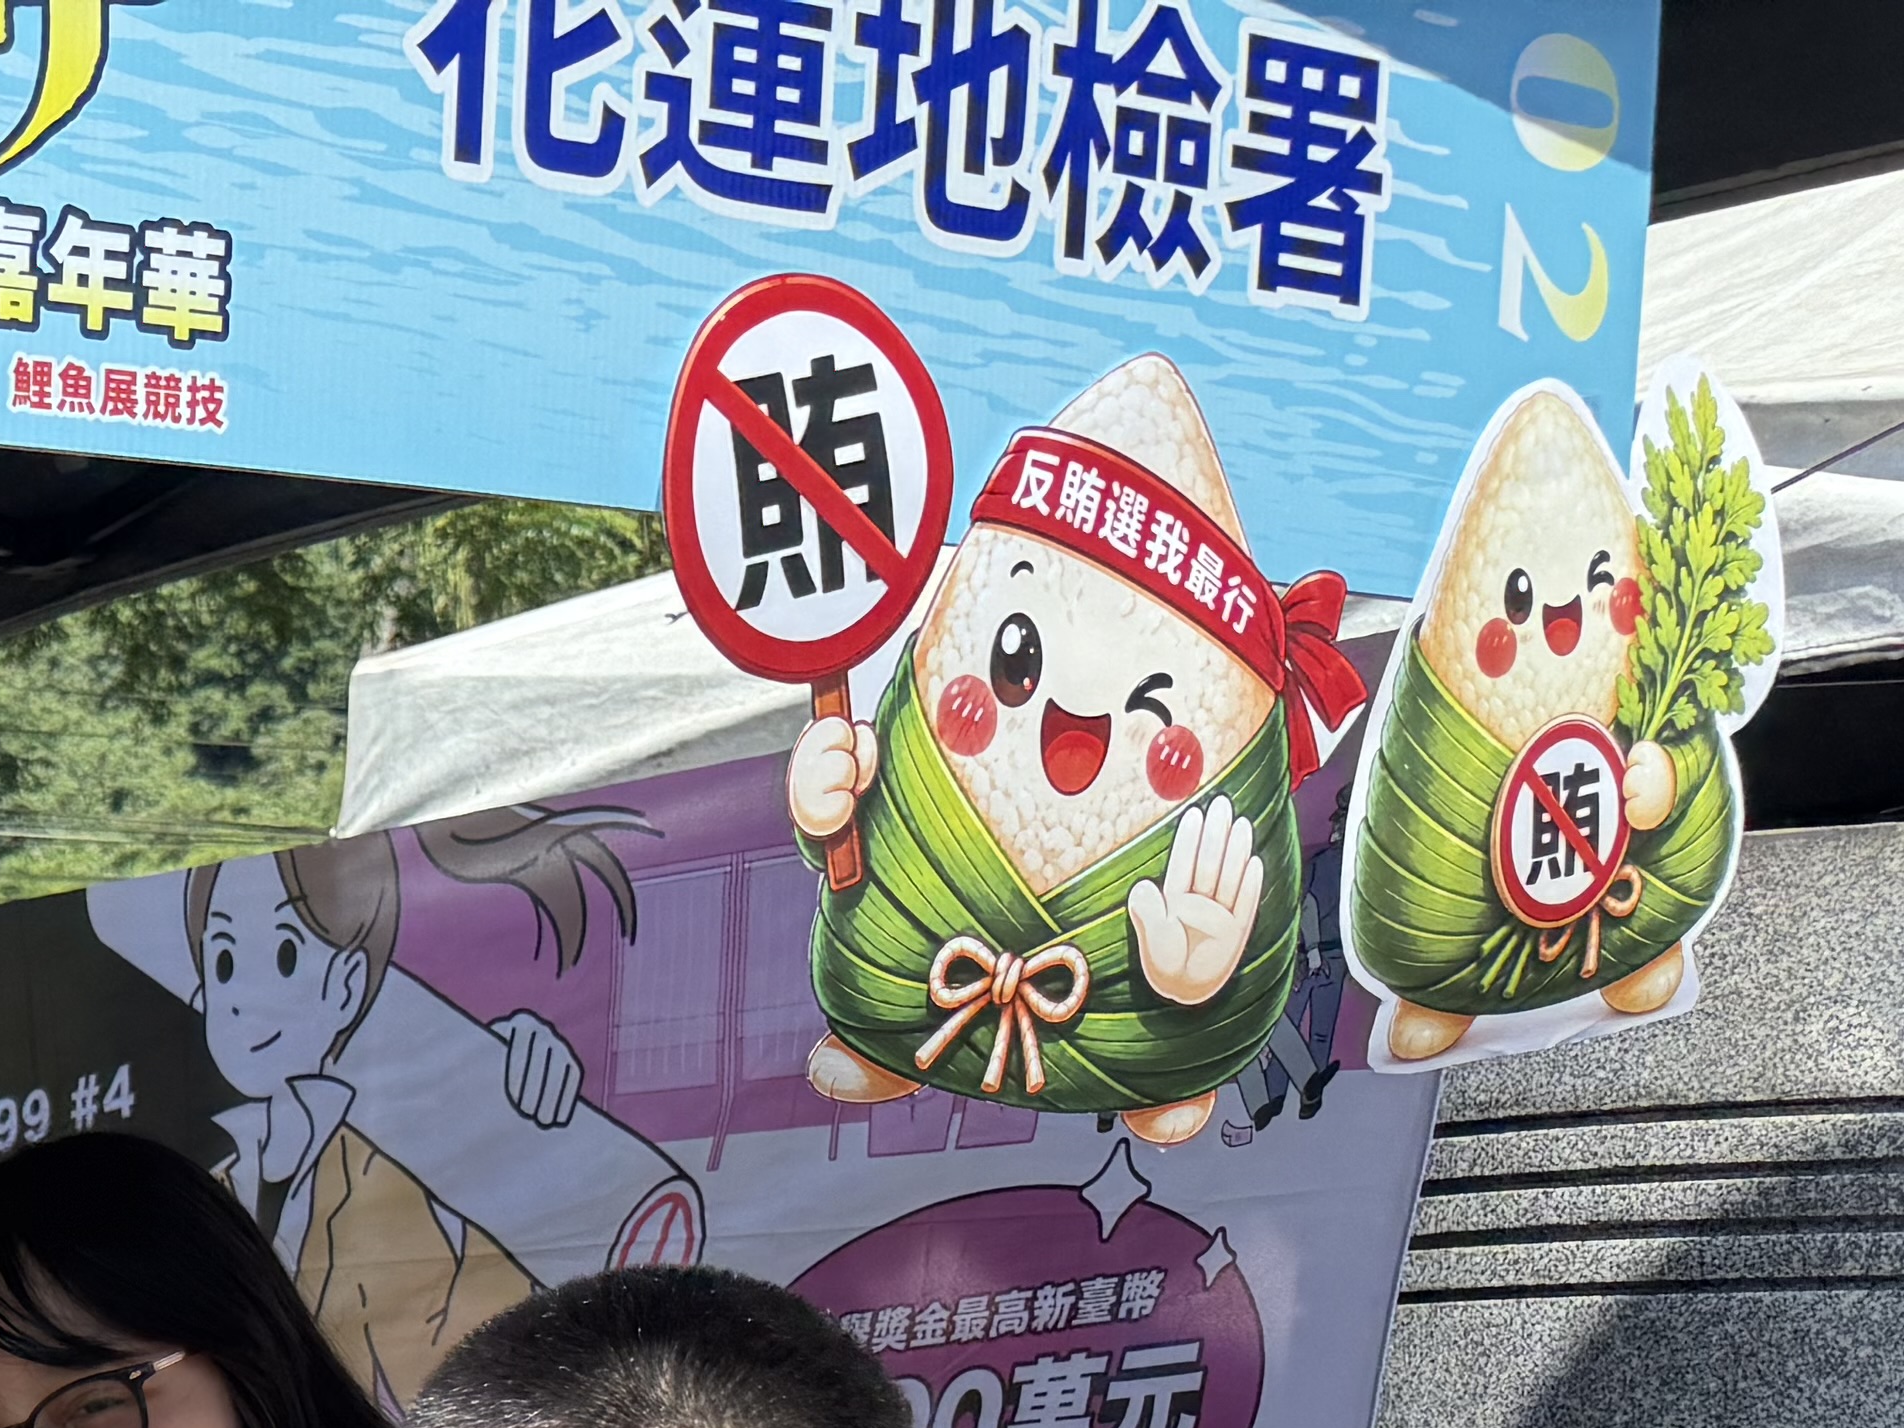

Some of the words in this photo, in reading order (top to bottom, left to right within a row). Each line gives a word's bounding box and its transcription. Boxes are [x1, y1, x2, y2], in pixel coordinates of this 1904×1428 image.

[725, 353, 898, 610] 賄
[1008, 451, 1259, 636] 反賄選我最行
[1526, 762, 1600, 886] 賄
[69, 1062, 136, 1131] #4
